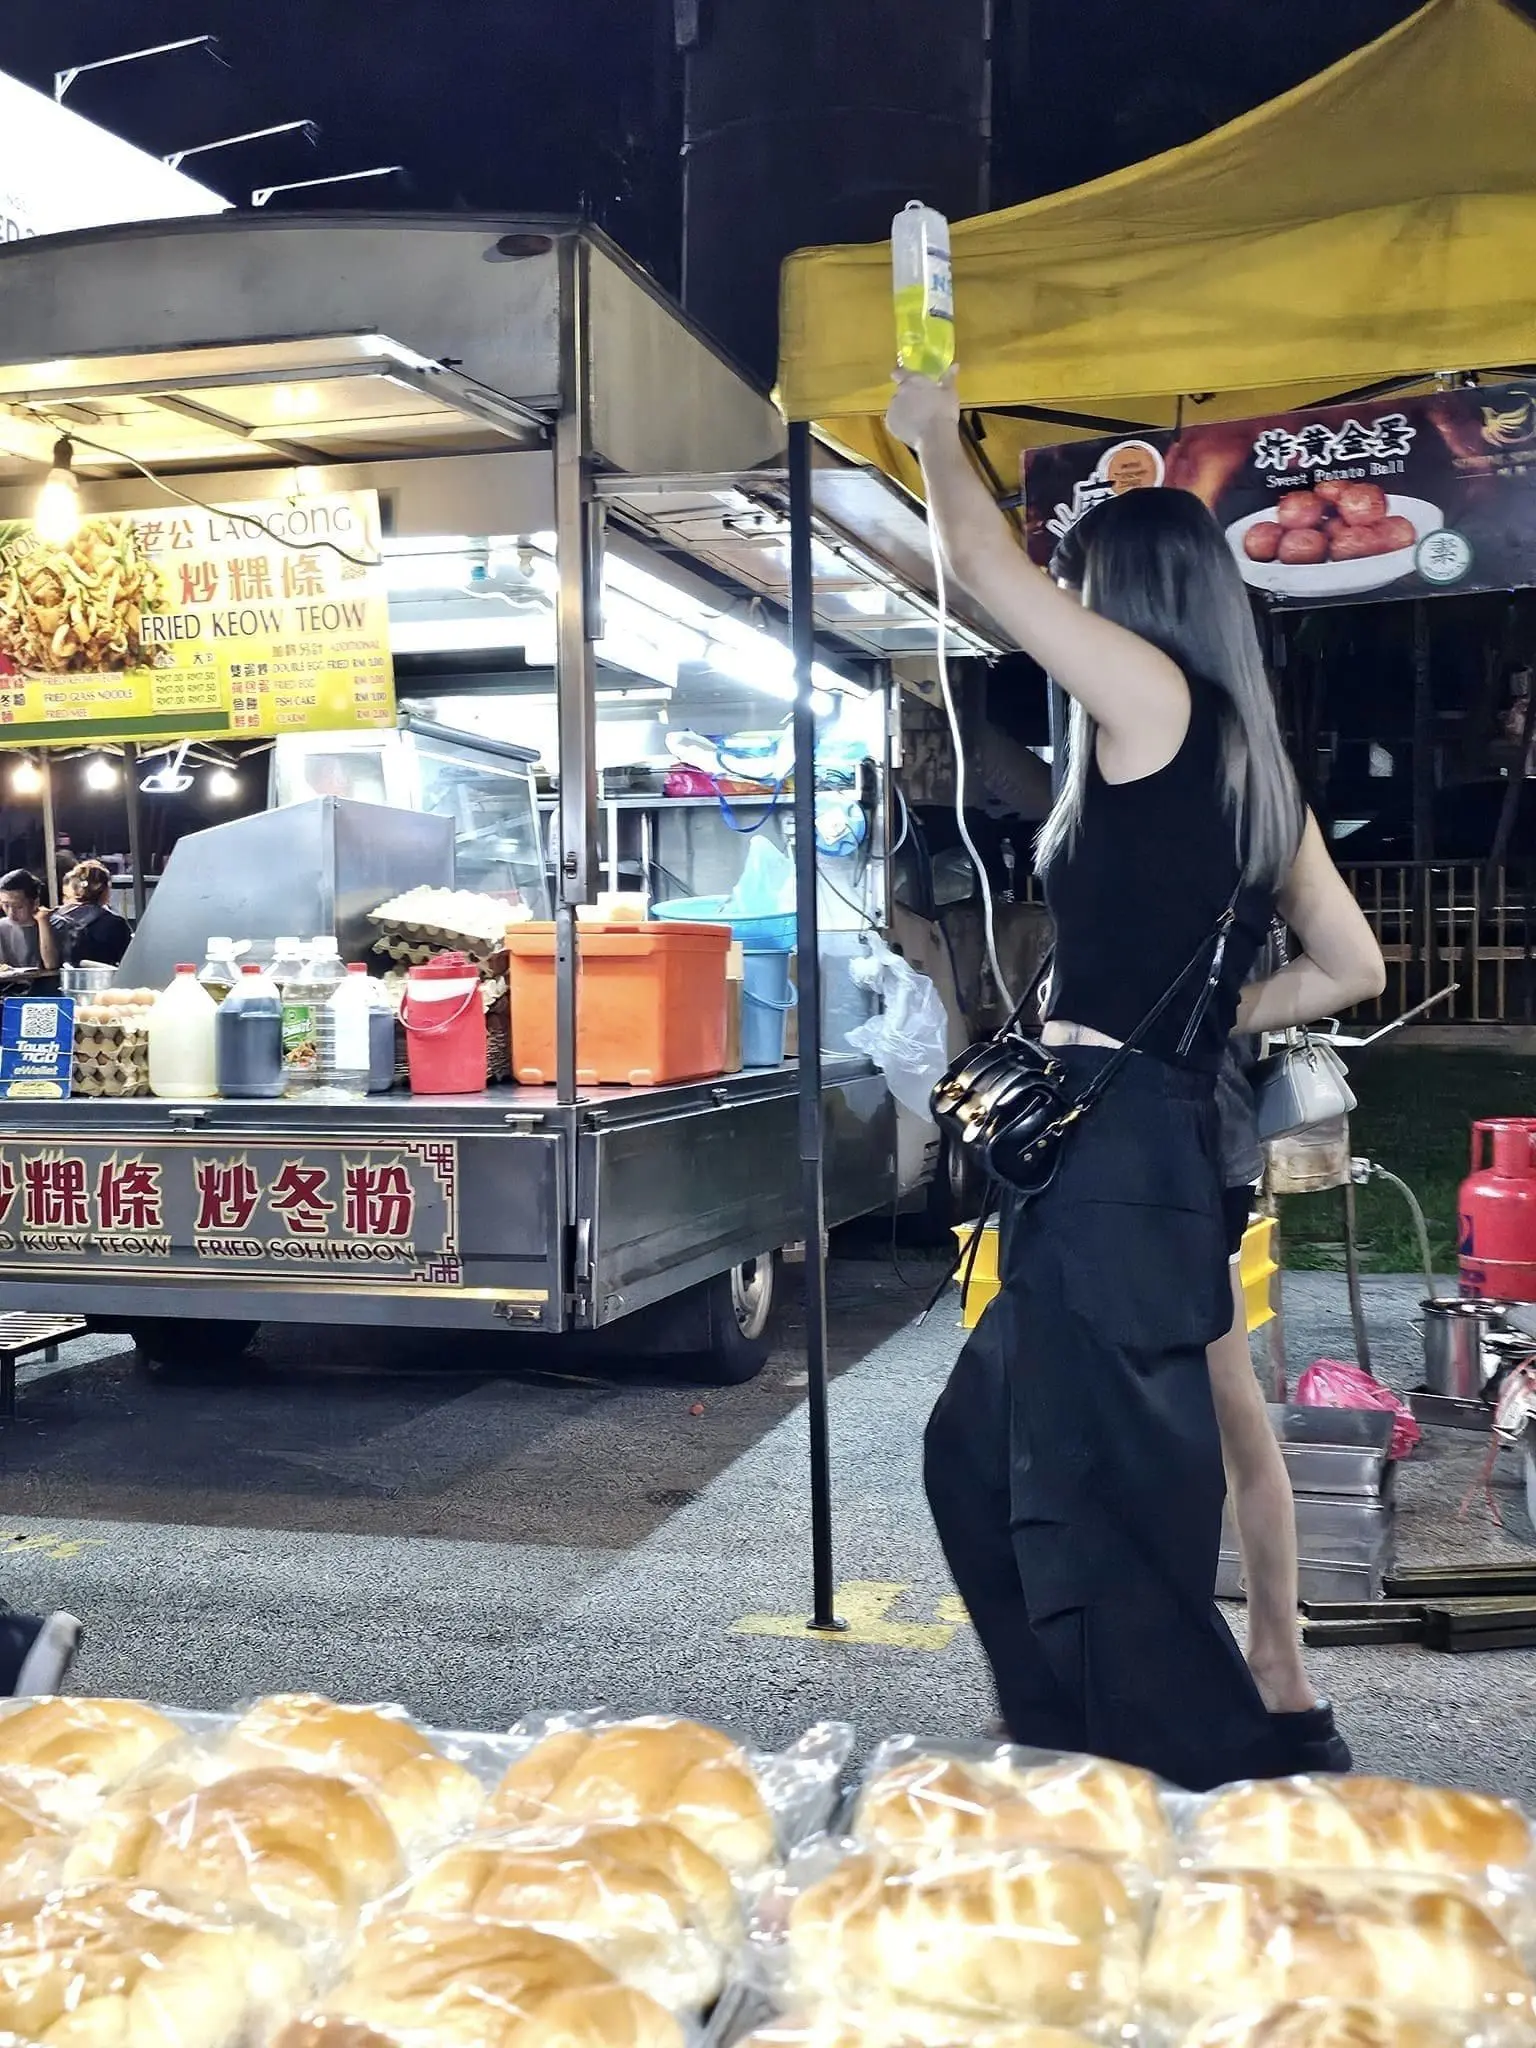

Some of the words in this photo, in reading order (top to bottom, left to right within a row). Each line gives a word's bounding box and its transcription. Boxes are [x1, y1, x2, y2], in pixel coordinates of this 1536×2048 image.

[1266, 473, 1309, 489] Sweet
[1314, 467, 1366, 483] Potato
[1370, 459, 1405, 476] Ball
[140, 519, 194, 553] 老公
[141, 613, 201, 642] FRIED
[212, 608, 284, 638] KEOW
[296, 602, 367, 632] TEOW
[15, 1041, 60, 1054] Touch
[196, 1160, 412, 1236] 炒冬粉
[24, 1234, 83, 1252] KUEY
[94, 1236, 168, 1255] TEOW
[197, 1238, 262, 1257] FRIED
[269, 1240, 326, 1261] SOH
[331, 1242, 415, 1263] HOON
